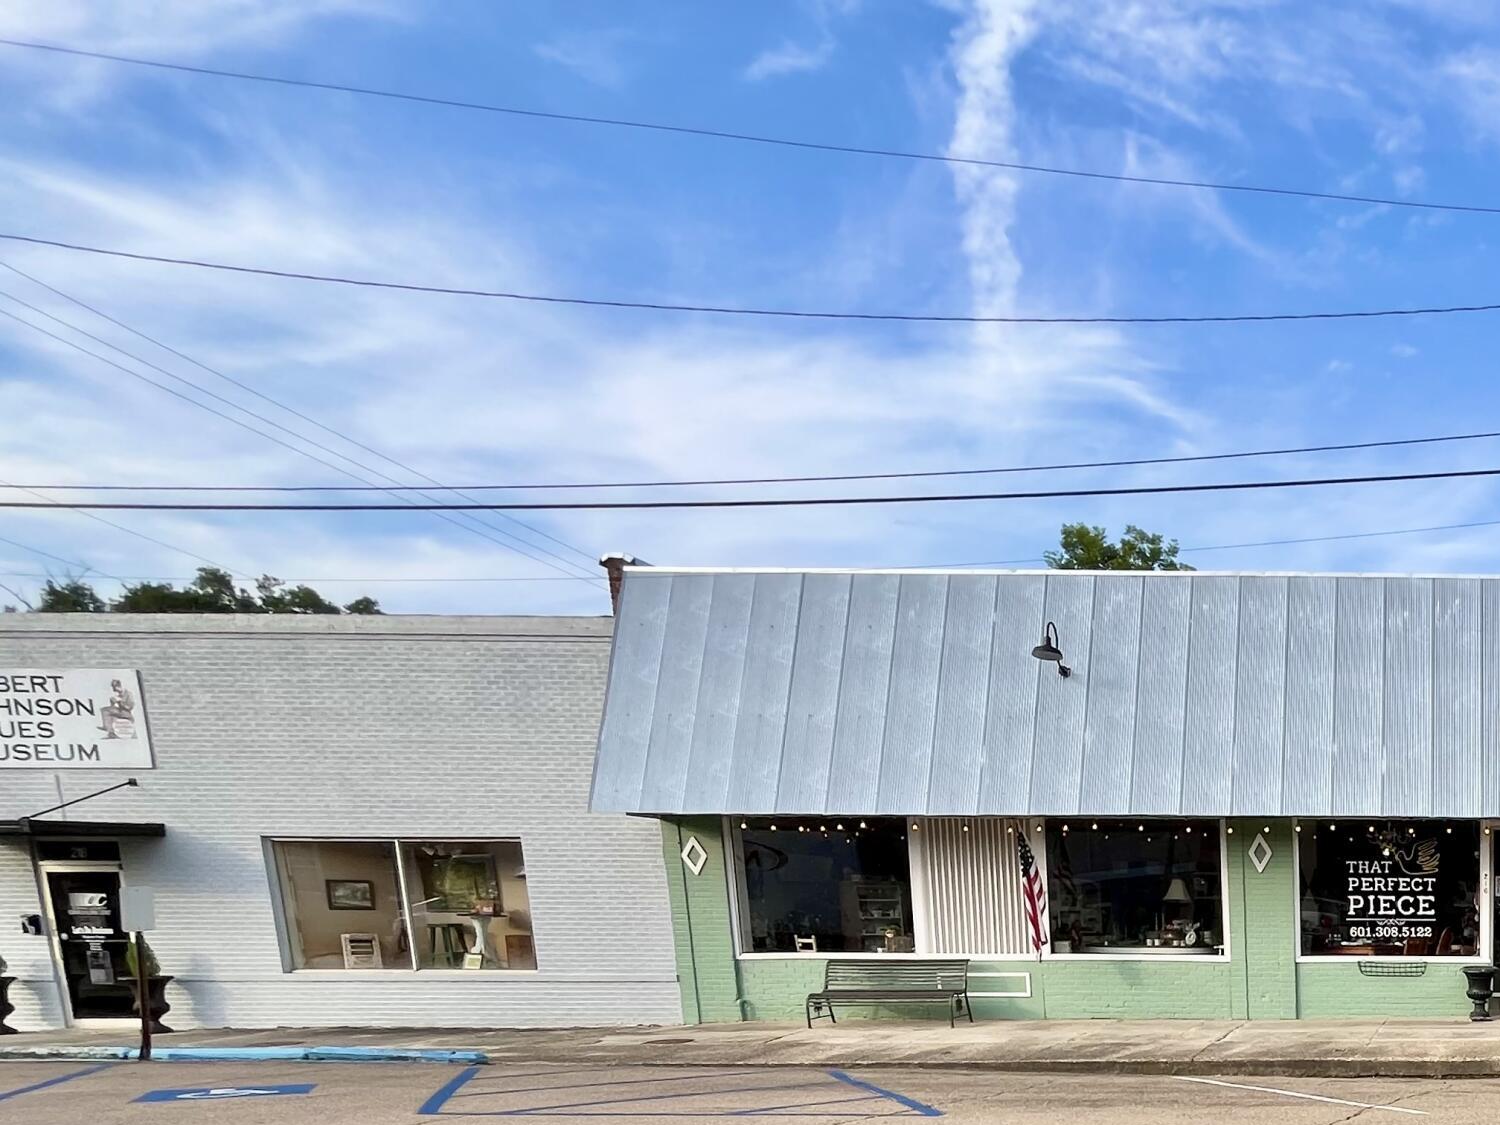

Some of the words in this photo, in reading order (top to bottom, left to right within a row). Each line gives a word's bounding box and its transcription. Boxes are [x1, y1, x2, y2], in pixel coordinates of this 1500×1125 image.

[1345, 860, 1393, 874] THAT
[1347, 877, 1437, 892] PERFECT
[1347, 895, 1436, 916] PIECE
[1349, 926, 1433, 938] 601.308.5122
